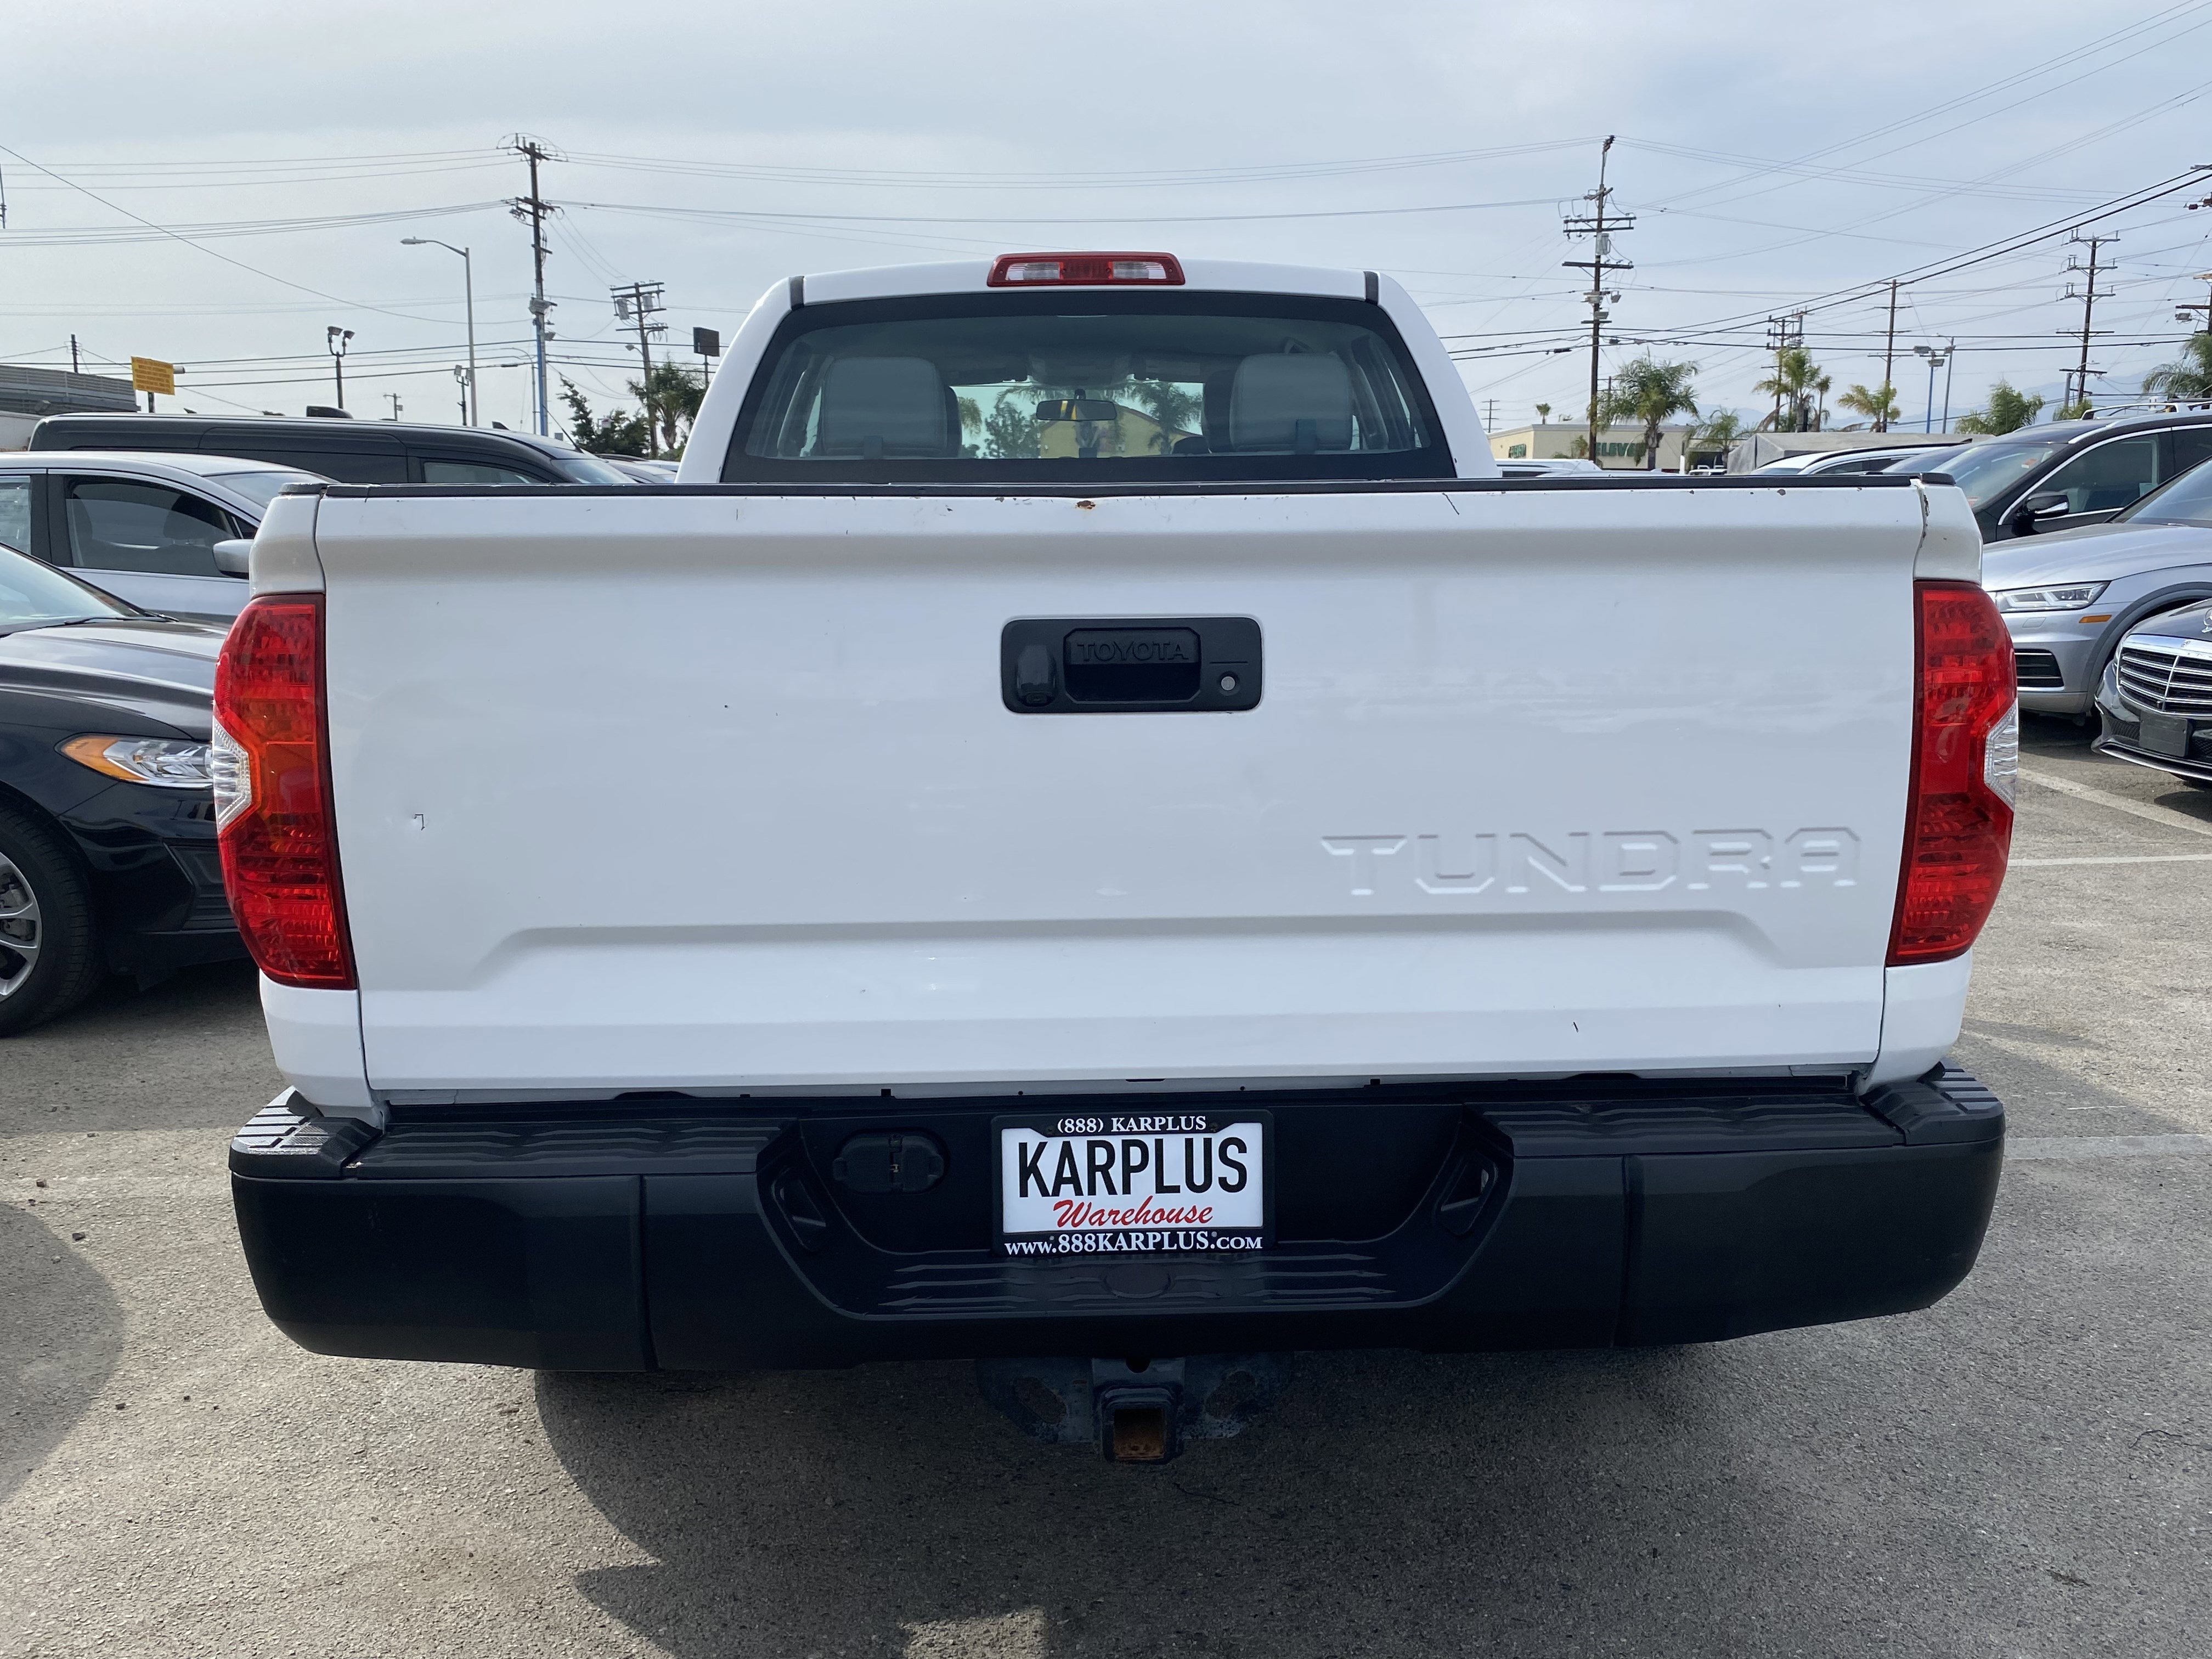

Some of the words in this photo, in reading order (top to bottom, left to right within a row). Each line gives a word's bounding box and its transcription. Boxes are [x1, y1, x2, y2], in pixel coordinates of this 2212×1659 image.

[1077, 642, 1189, 662] TOYOTA
[1321, 826, 1861, 895] TUNDRA
[1057, 1117, 1104, 1133] (888)
[1111, 1116, 1206, 1132] KARPLUS
[1018, 1137, 1248, 1198] KARPLUS
[1052, 1195, 1213, 1228] Warehouse
